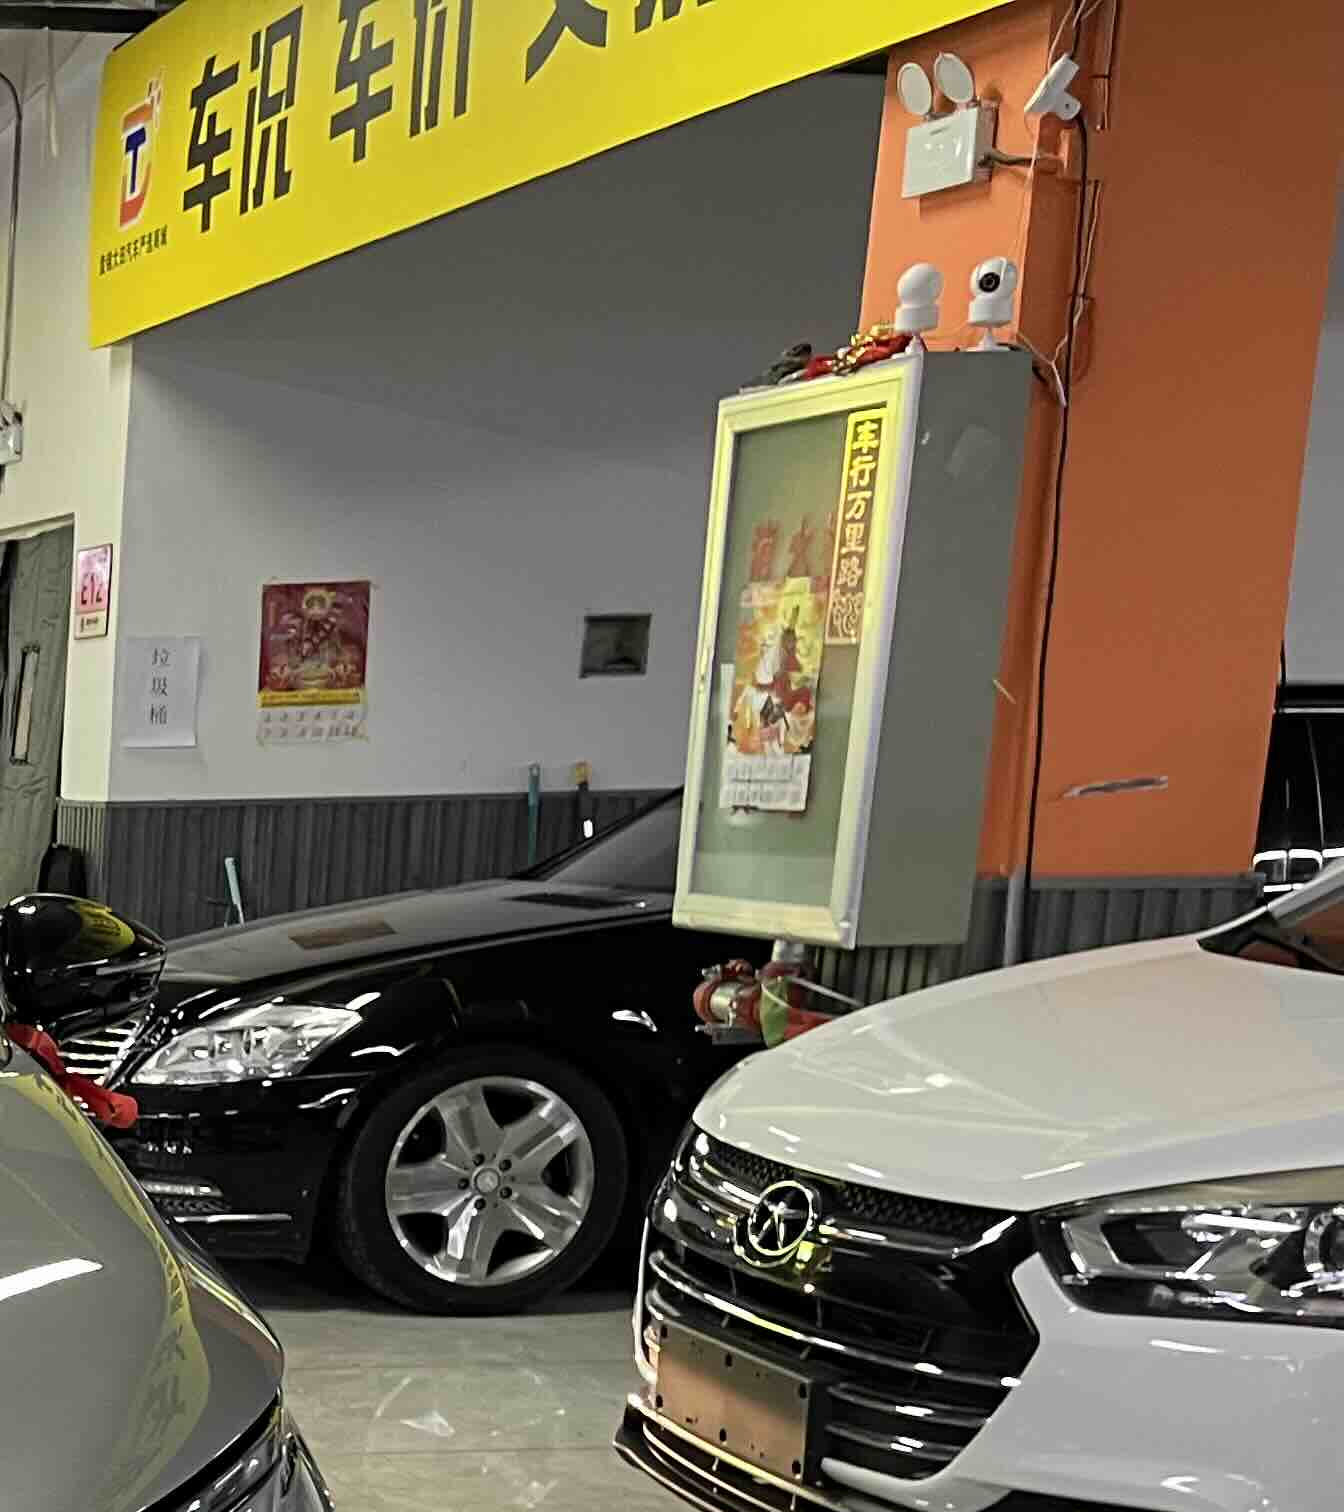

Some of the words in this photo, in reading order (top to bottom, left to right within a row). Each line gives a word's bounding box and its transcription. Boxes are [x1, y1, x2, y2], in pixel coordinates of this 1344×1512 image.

[183, 6, 304, 233] 车况
[835, 420, 880, 587] 车行万里路
